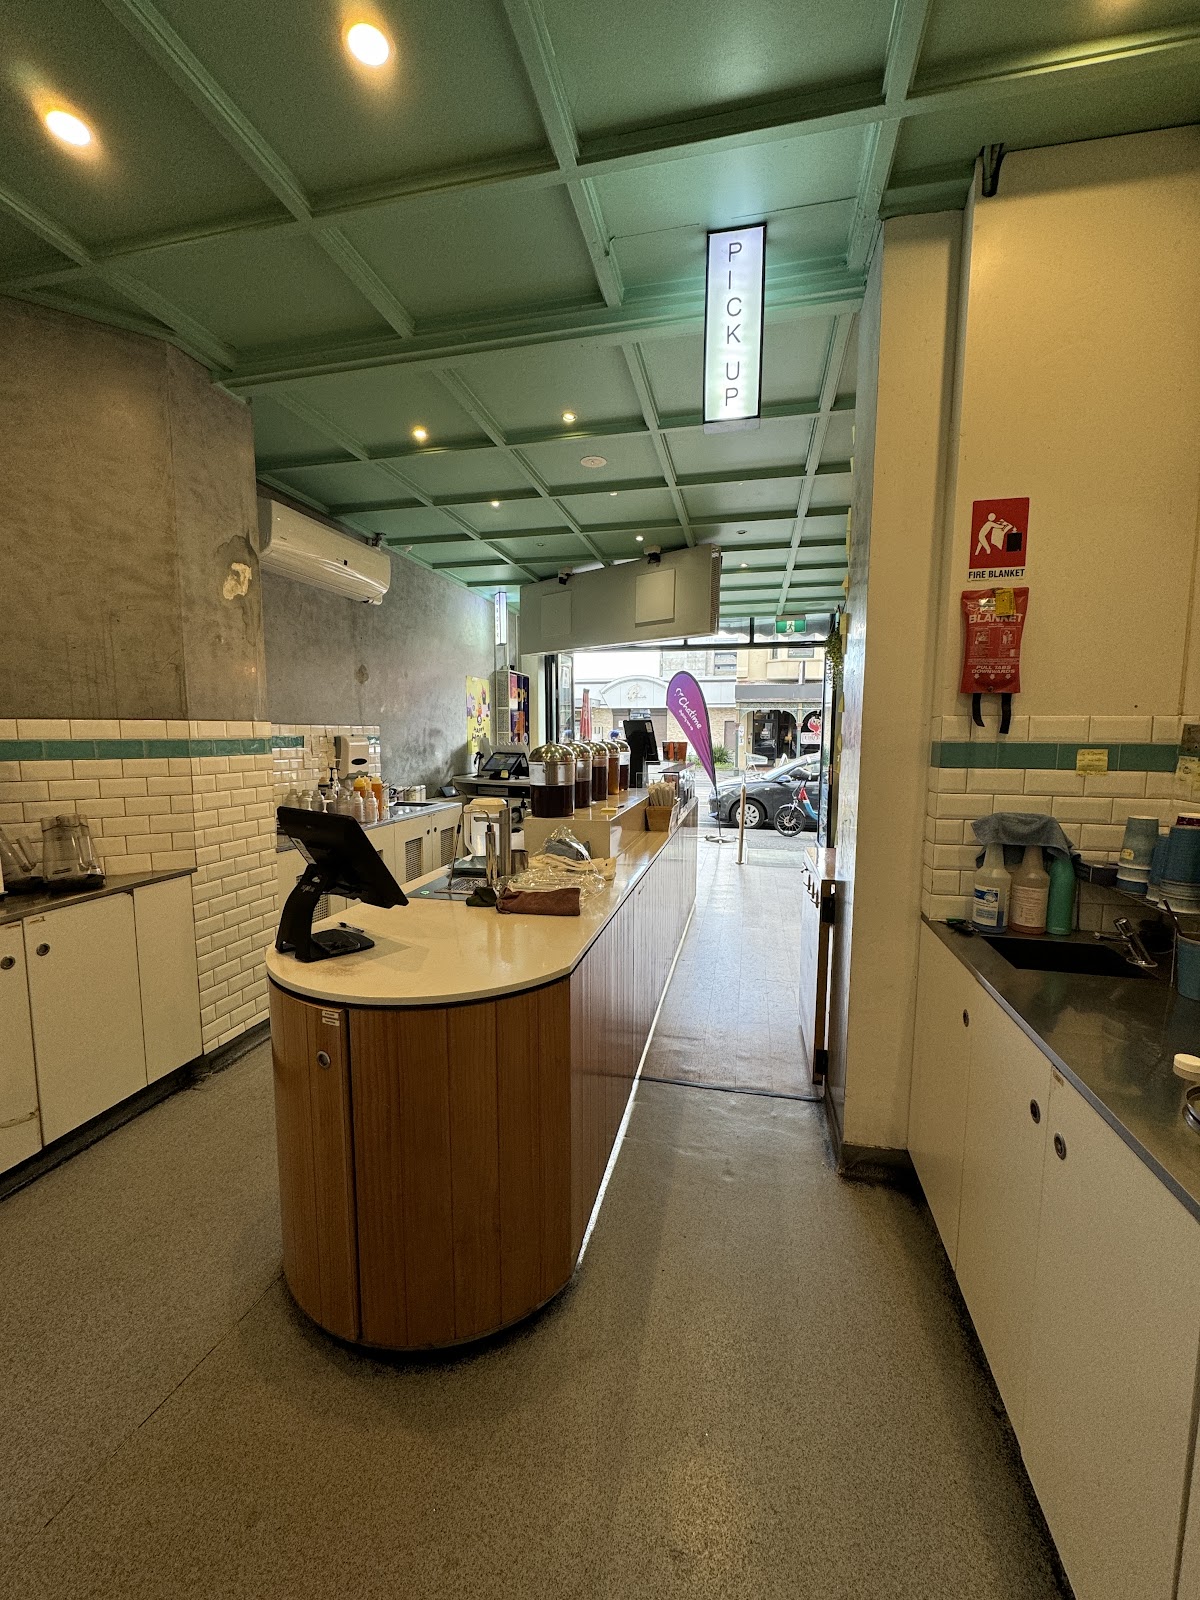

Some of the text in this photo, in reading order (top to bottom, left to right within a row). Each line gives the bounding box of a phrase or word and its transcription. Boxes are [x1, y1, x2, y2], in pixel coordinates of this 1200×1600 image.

[725, 242, 743, 407] PICK UP
[968, 568, 1025, 579] FIRE BLANKET
[678, 697, 702, 730] Chatime
